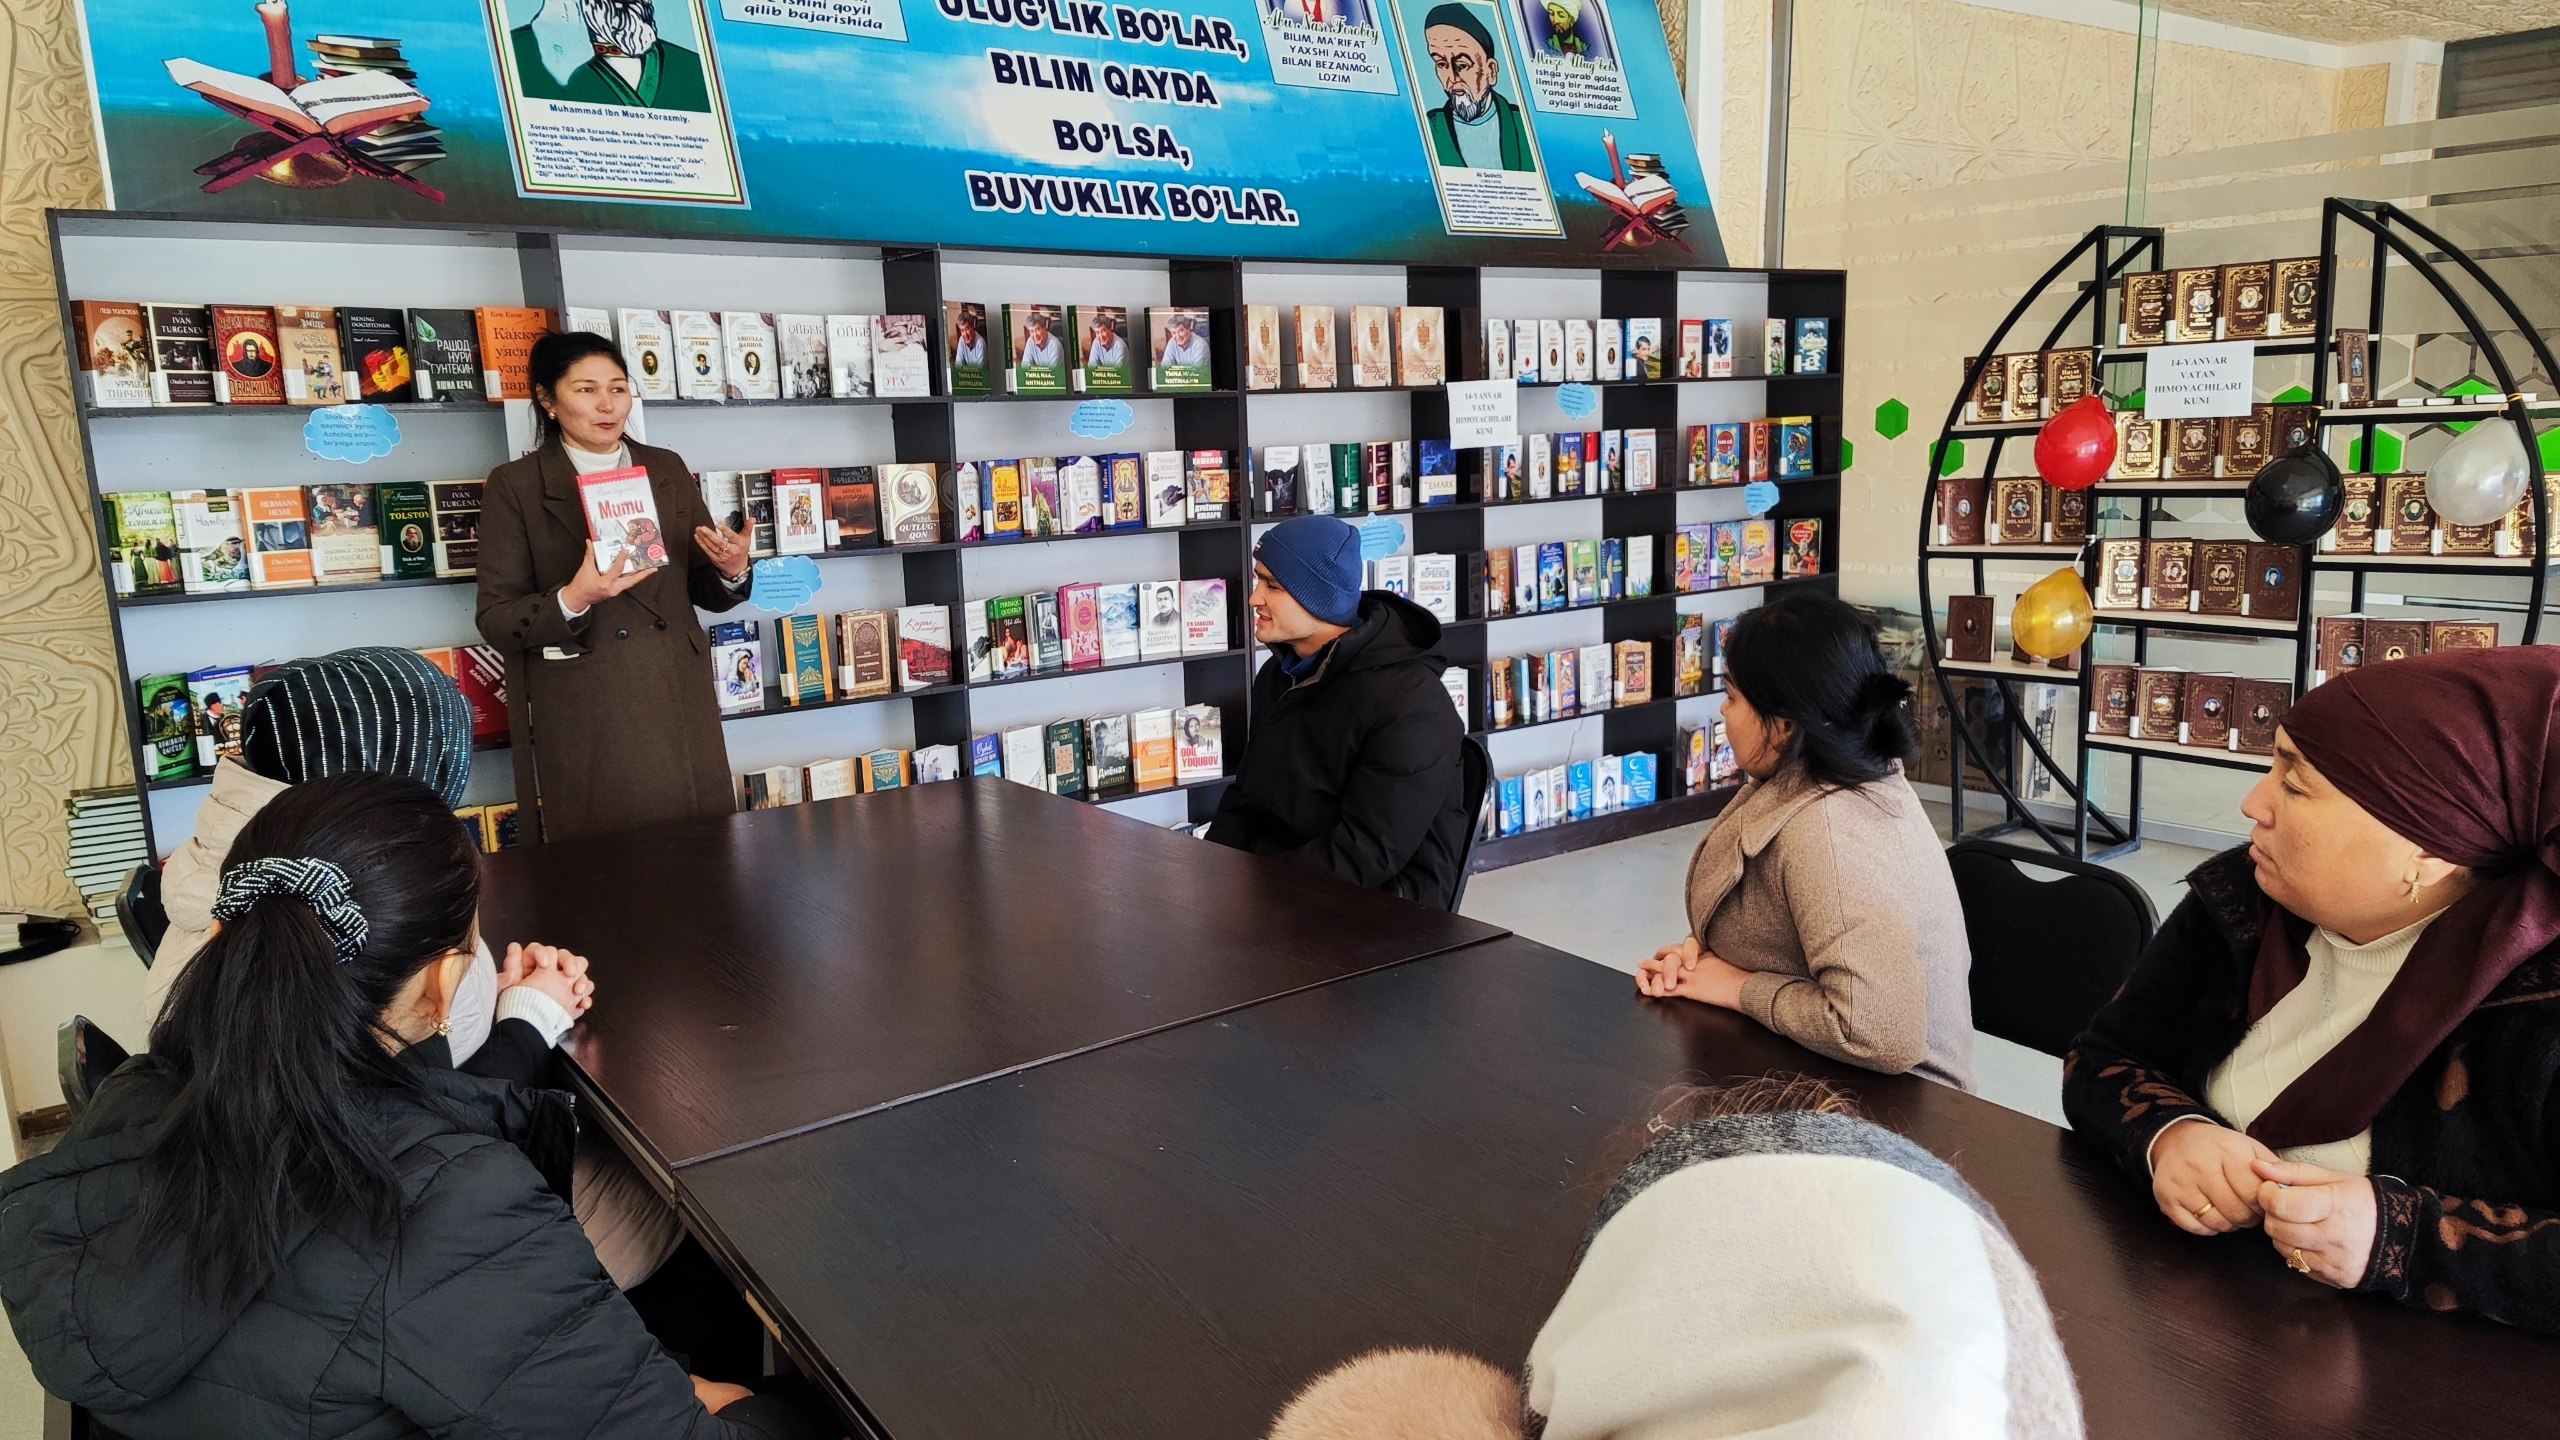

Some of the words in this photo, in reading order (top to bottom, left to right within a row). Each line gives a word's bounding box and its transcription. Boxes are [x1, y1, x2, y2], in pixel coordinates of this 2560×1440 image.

[833, 4, 871, 16] qoyil
[744, 4, 782, 17] qilib
[788, 9, 882, 29] bajarishida
[1116, 9, 1246, 59] BO'LAR,
[1283, 32, 1314, 44] BILIM,
[1317, 36, 1366, 48] MA'RIFAT
[1290, 45, 1329, 57] YAXSHI
[1333, 51, 1366, 63] AXLOQ
[1282, 57, 1311, 67] BILAN
[1316, 62, 1379, 74] BEZANMOG'I
[991, 52, 1094, 93] BILIM
[1104, 65, 1218, 105] QAYDA
[1319, 73, 1350, 83] LOZIM
[1536, 69, 1561, 78] Ishga
[1564, 72, 1591, 80] yarab
[1594, 75, 1617, 83] qolsa
[1536, 79, 1565, 89] ilming
[1542, 89, 1565, 97] Yana
[1569, 92, 1621, 103] oshirmoqqa
[1549, 100, 1580, 109] aylagil
[549, 104, 602, 116] Muhammad
[605, 108, 619, 117] Ibn
[622, 110, 645, 119] Muso
[647, 112, 690, 124] Xorazmiy.
[1053, 119, 1189, 166] BO'LSA,
[968, 175, 1160, 216] BUYUKLIK
[1167, 187, 1295, 222] BO'LAR.
[172, 316, 191, 324] IVAN
[161, 325, 204, 334] TURGENEV
[494, 327, 538, 342] Какку
[836, 324, 871, 337] ОЙБЕ
[437, 340, 470, 351] РАШОД
[448, 352, 472, 362] НУРИ
[496, 348, 528, 359] уяси
[2171, 356, 2227, 366] 14-YANVAR
[431, 364, 474, 374] ГУНТЕКИН
[2180, 370, 2216, 379] VATAN
[2154, 382, 2241, 393] HIMOYACHILARI
[1465, 392, 1502, 400] 14-YANVAR
[2183, 397, 2209, 405] KUNI
[1455, 415, 1511, 424] HIMOYACHILARI
[1476, 427, 1493, 435] KUNI
[260, 500, 298, 508] HERMANN
[597, 499, 645, 520] Mumu
[389, 511, 430, 520] TOLSTOY
[909, 531, 927, 539] QON
[1458, 694, 1465, 706] 2
[1181, 747, 1197, 757] ODIL
[1182, 756, 1218, 768] YOQUBOV
[1098, 765, 1126, 779] Диёнат
